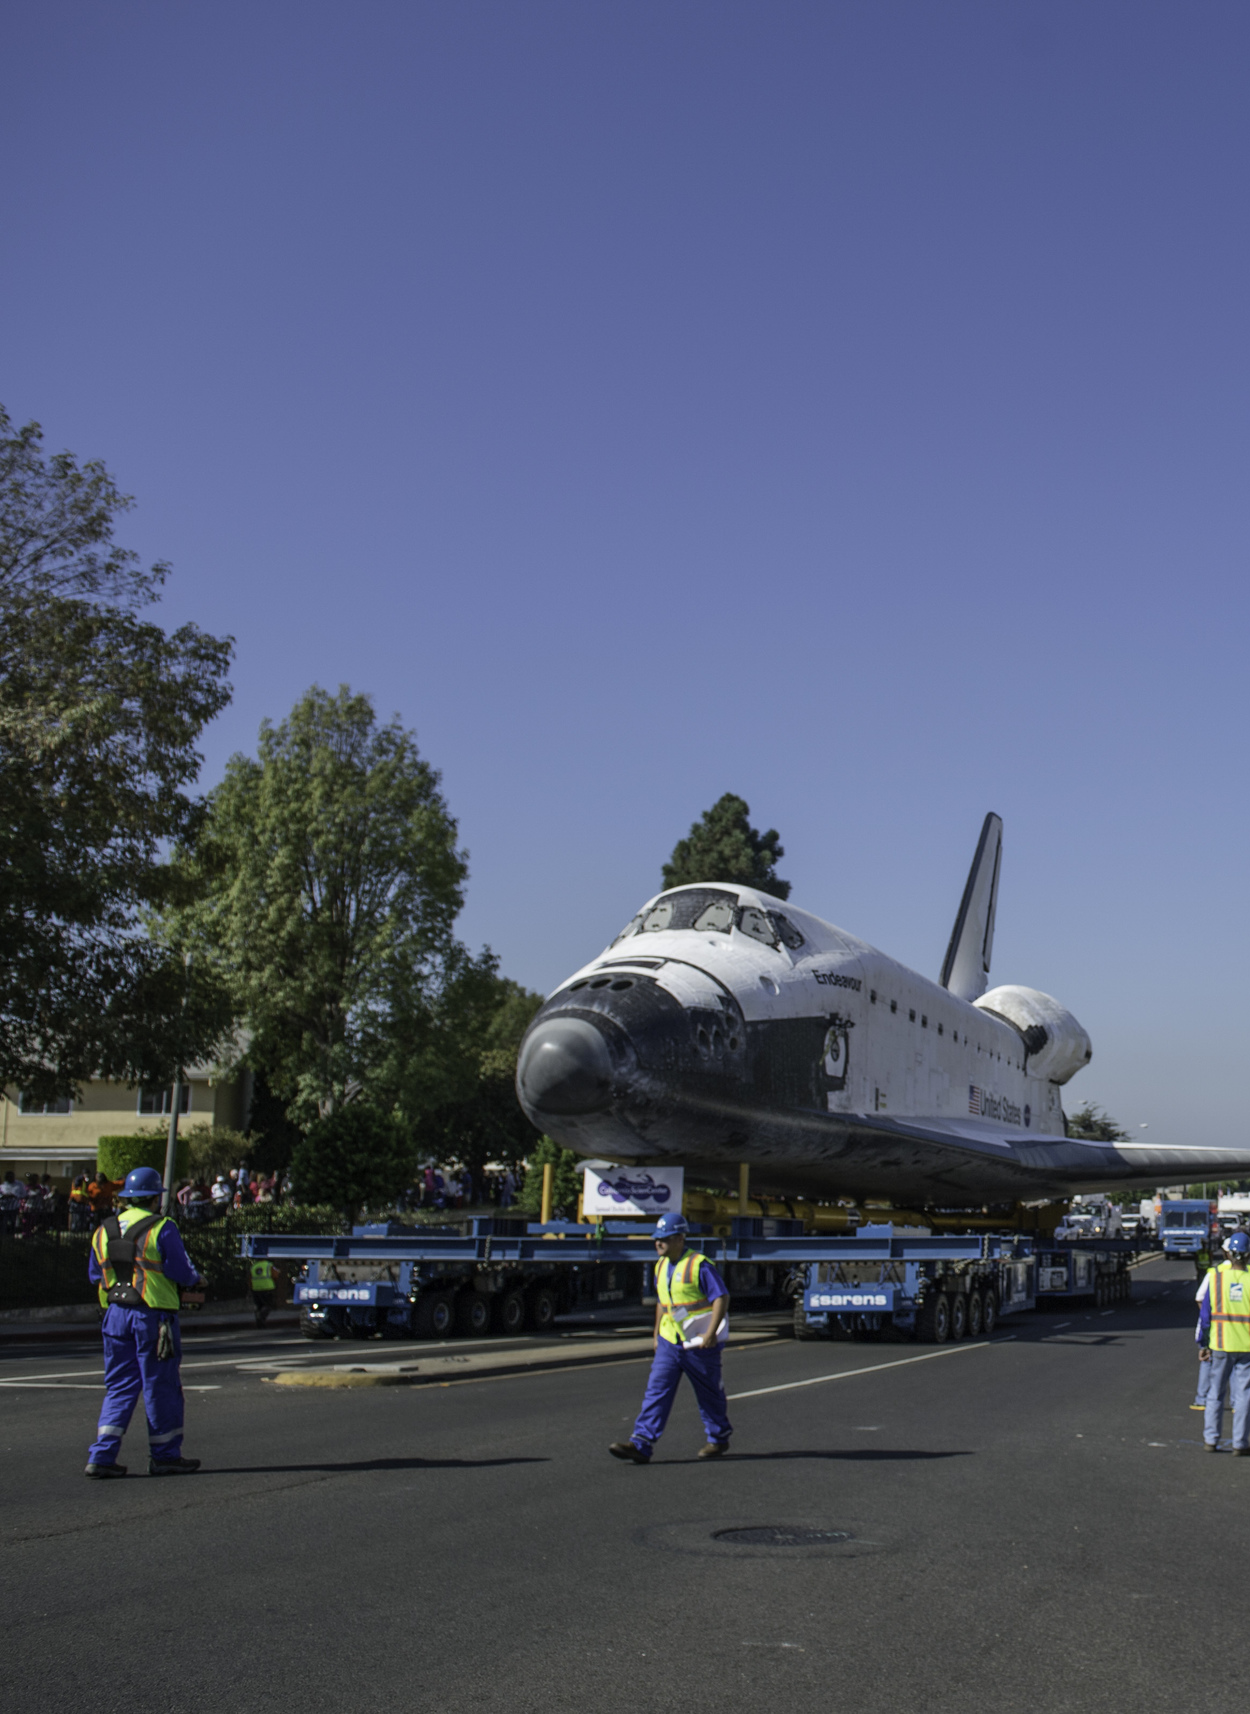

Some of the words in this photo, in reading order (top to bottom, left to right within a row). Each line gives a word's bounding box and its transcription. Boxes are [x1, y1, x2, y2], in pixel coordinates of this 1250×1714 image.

[811, 969, 862, 992] Endeavour
[980, 1089, 1001, 1120] United
[1002, 1096, 1021, 1126] States
[308, 1289, 370, 1301] sarens
[820, 1294, 887, 1306] sarens
